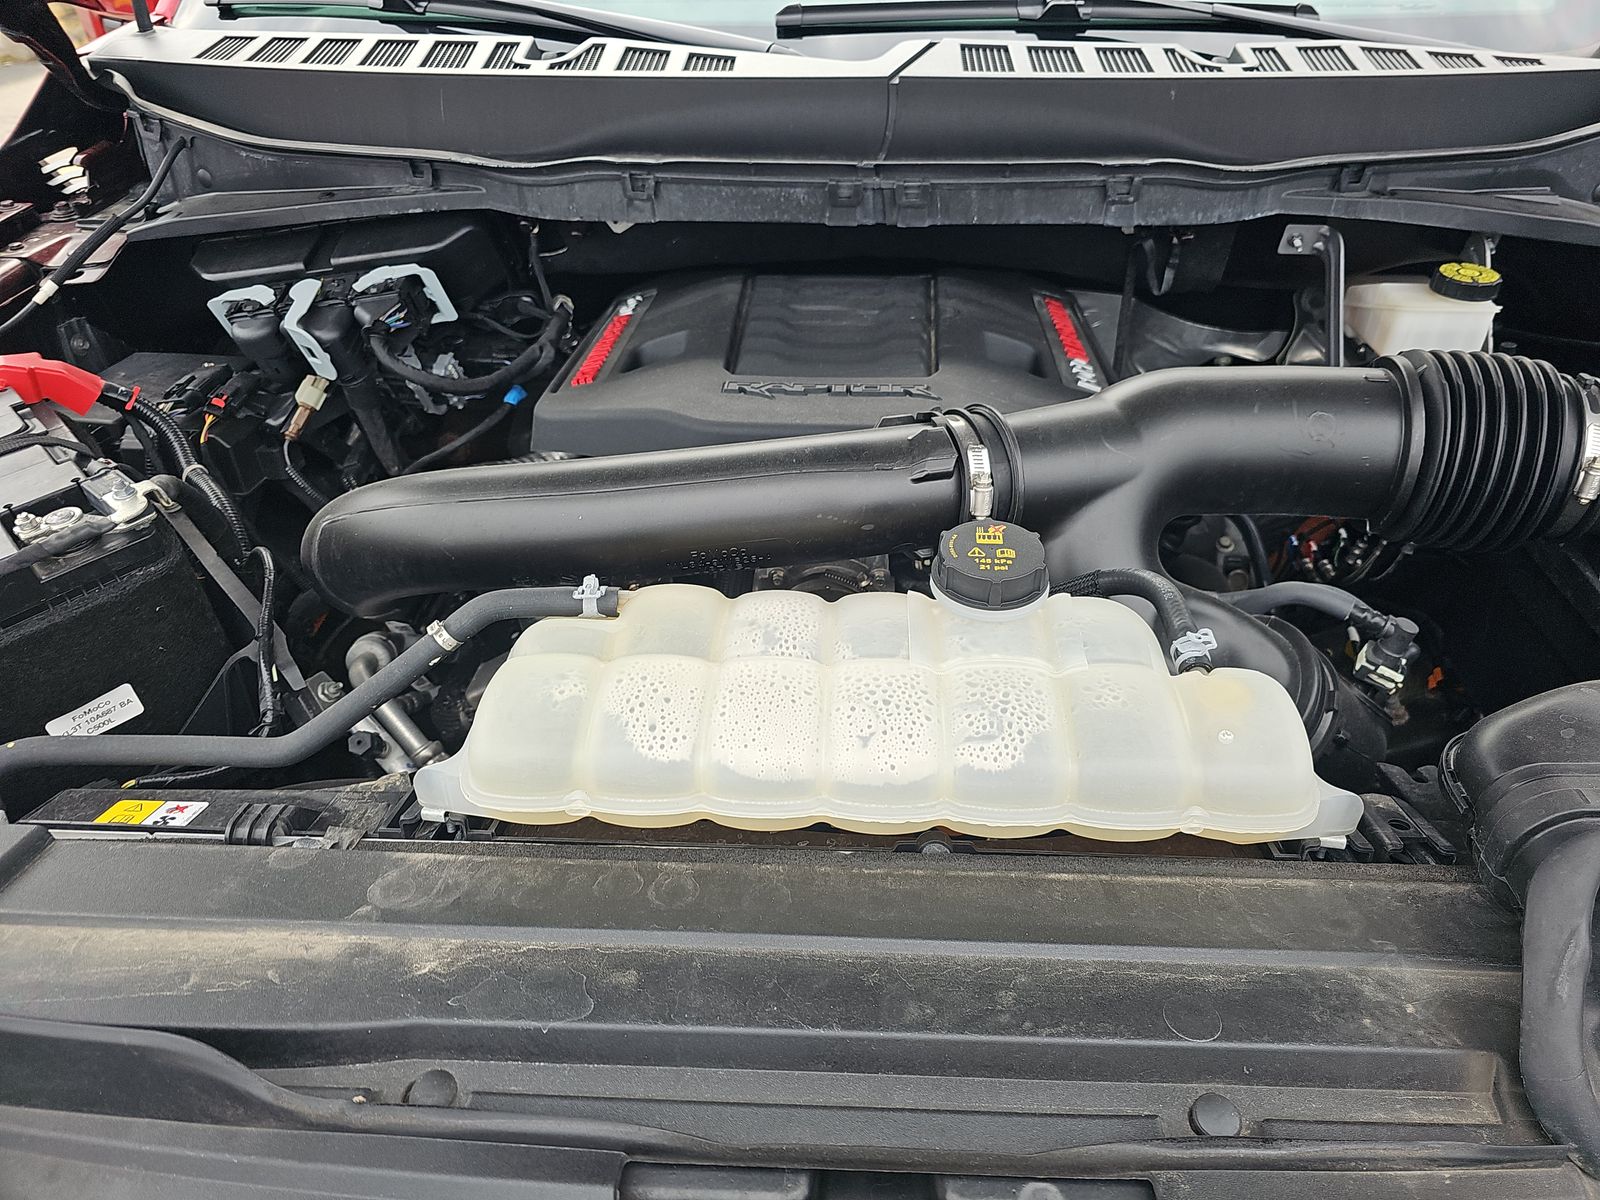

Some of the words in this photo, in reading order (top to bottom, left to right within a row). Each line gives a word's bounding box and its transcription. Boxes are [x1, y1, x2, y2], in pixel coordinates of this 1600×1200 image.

[71, 700, 111, 723] FoMoCo
[119, 698, 134, 709] BA
[86, 717, 117, 735] C500L
